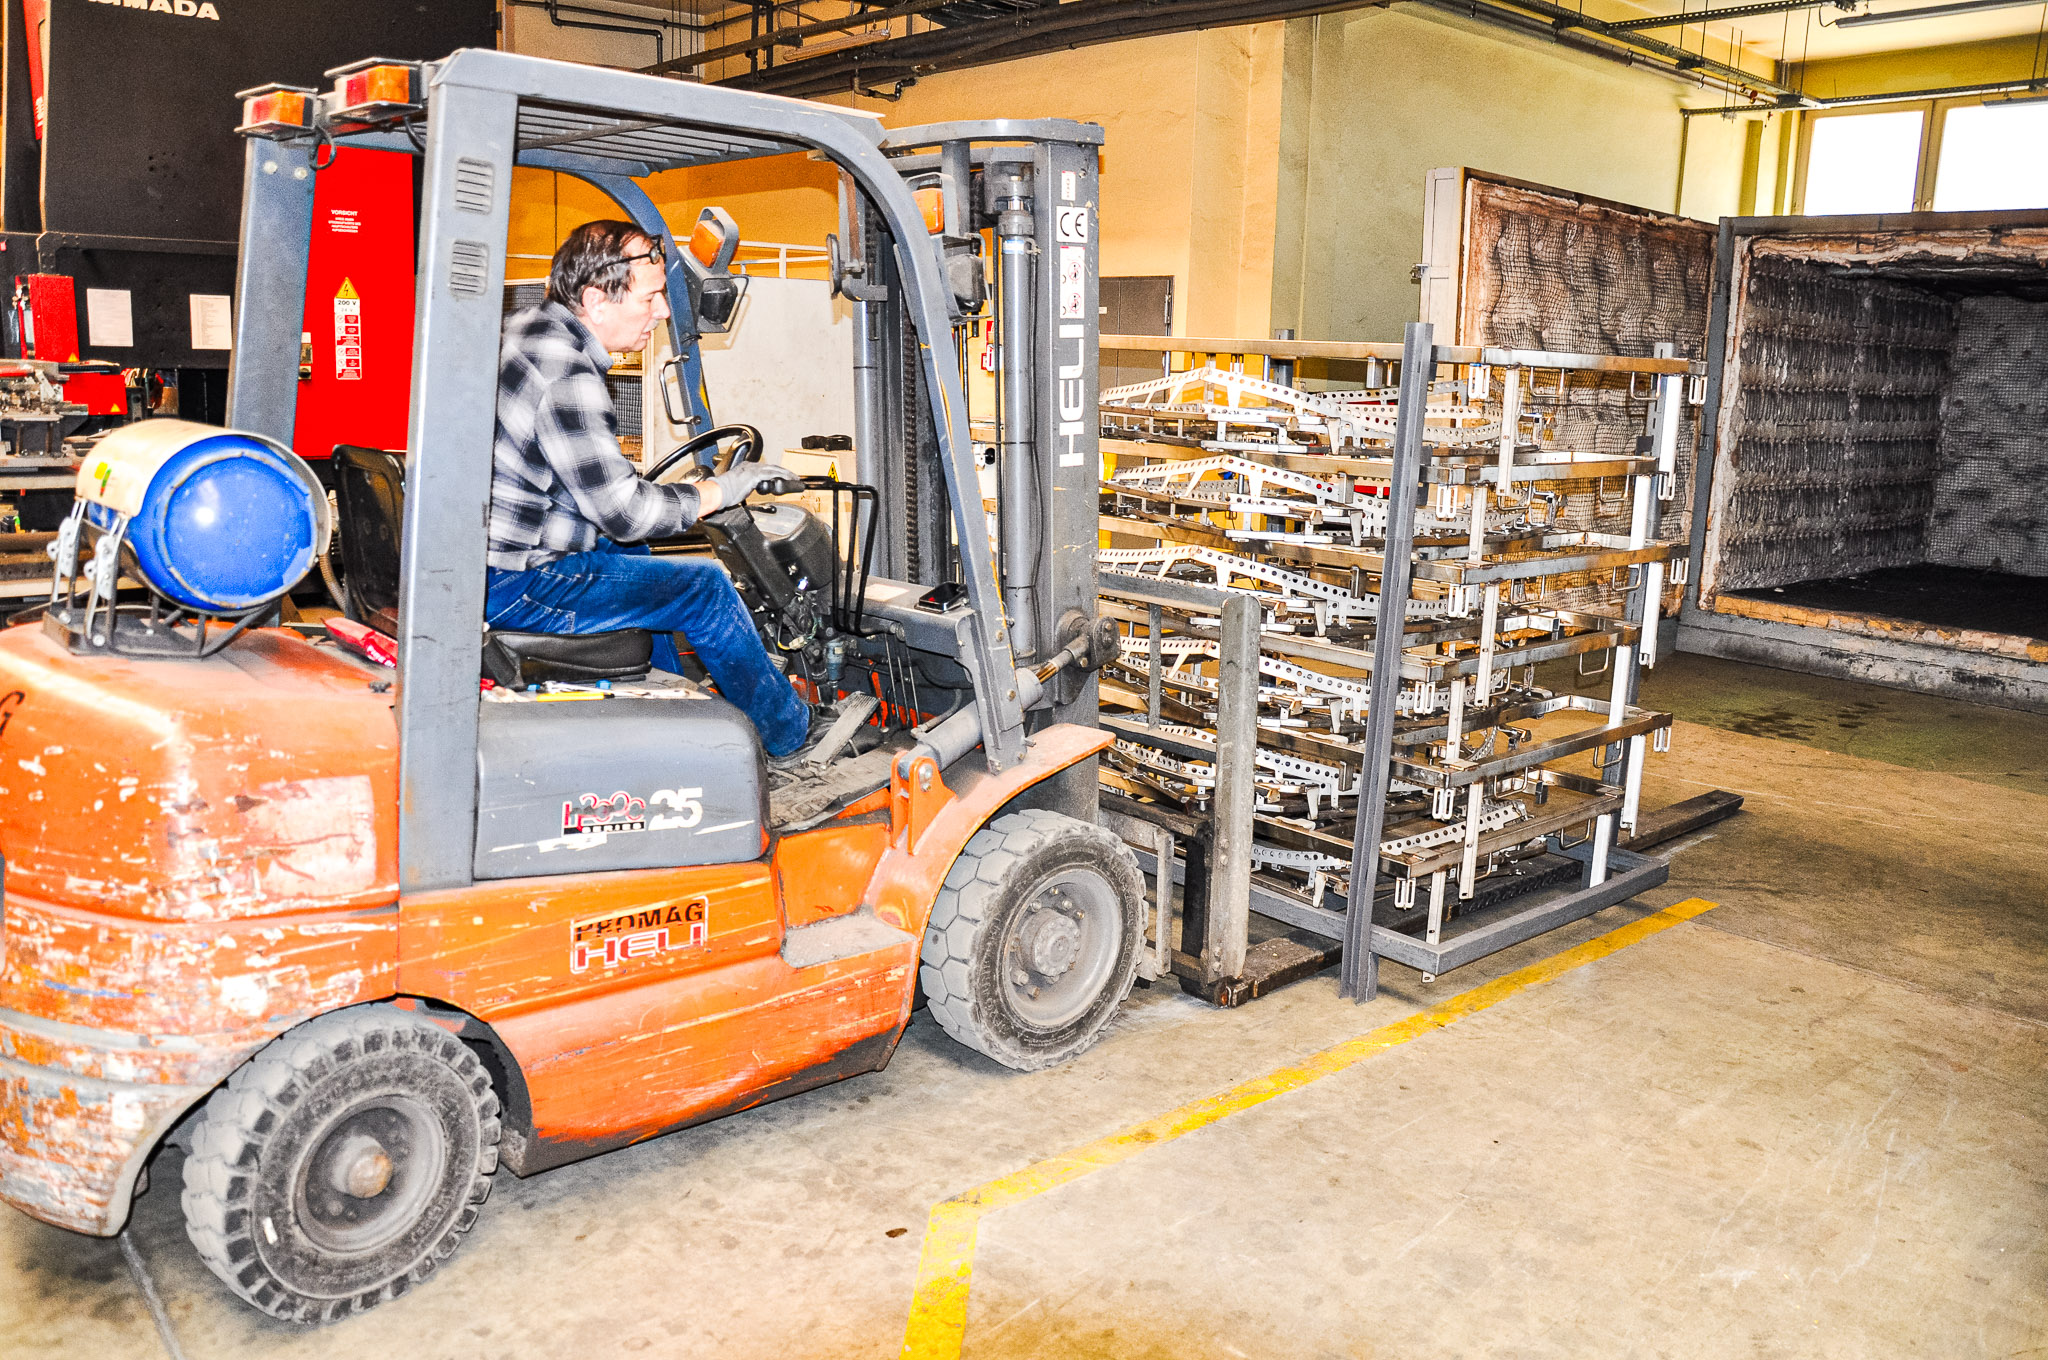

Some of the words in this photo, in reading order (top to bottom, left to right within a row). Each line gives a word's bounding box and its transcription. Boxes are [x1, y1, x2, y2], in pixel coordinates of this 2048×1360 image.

[1059, 324, 1085, 467] HELI
[648, 787, 703, 831] 25
[575, 902, 704, 941] PROMAG
[574, 922, 704, 971] HELI
